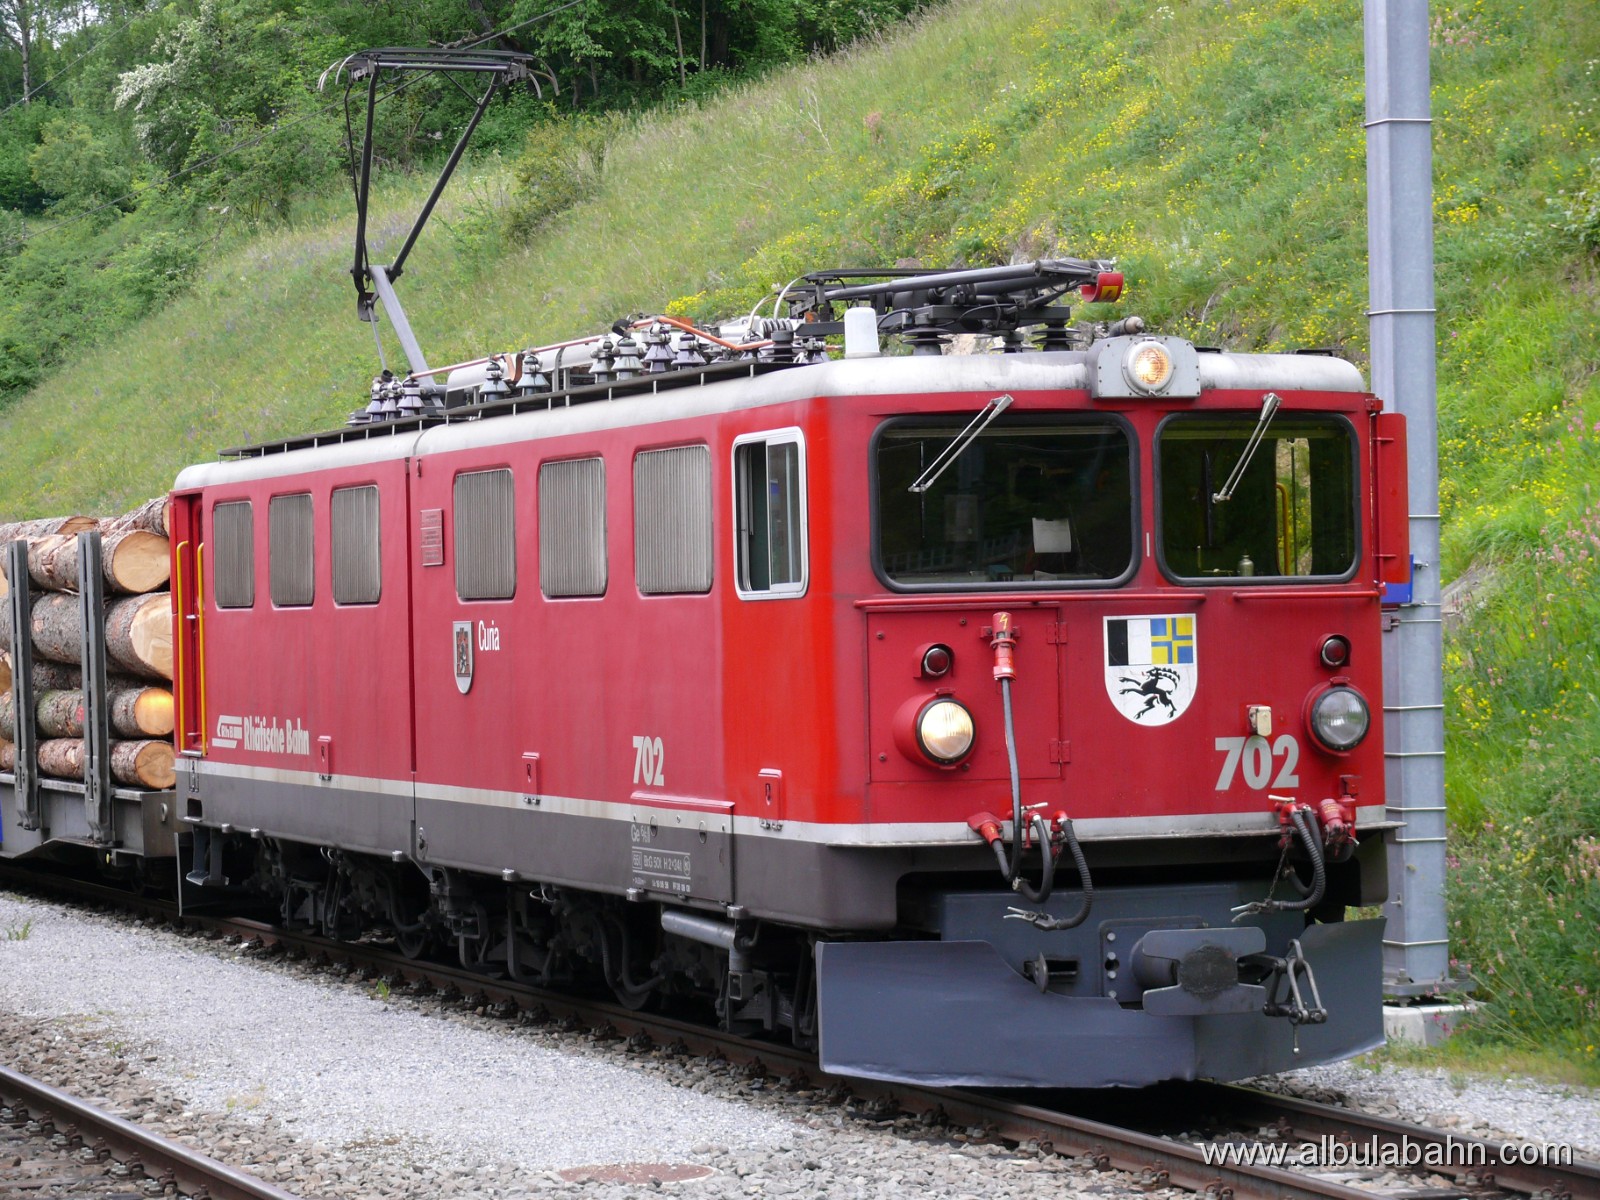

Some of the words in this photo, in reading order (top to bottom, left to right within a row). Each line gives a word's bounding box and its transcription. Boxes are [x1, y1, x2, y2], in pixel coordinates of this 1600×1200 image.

[478, 619, 500, 651] Curia
[244, 715, 285, 754] Rhätische
[285, 717, 310, 755] Bahn
[632, 735, 665, 787] 702
[1214, 733, 1300, 791] 702
[630, 823, 640, 843] Ge
